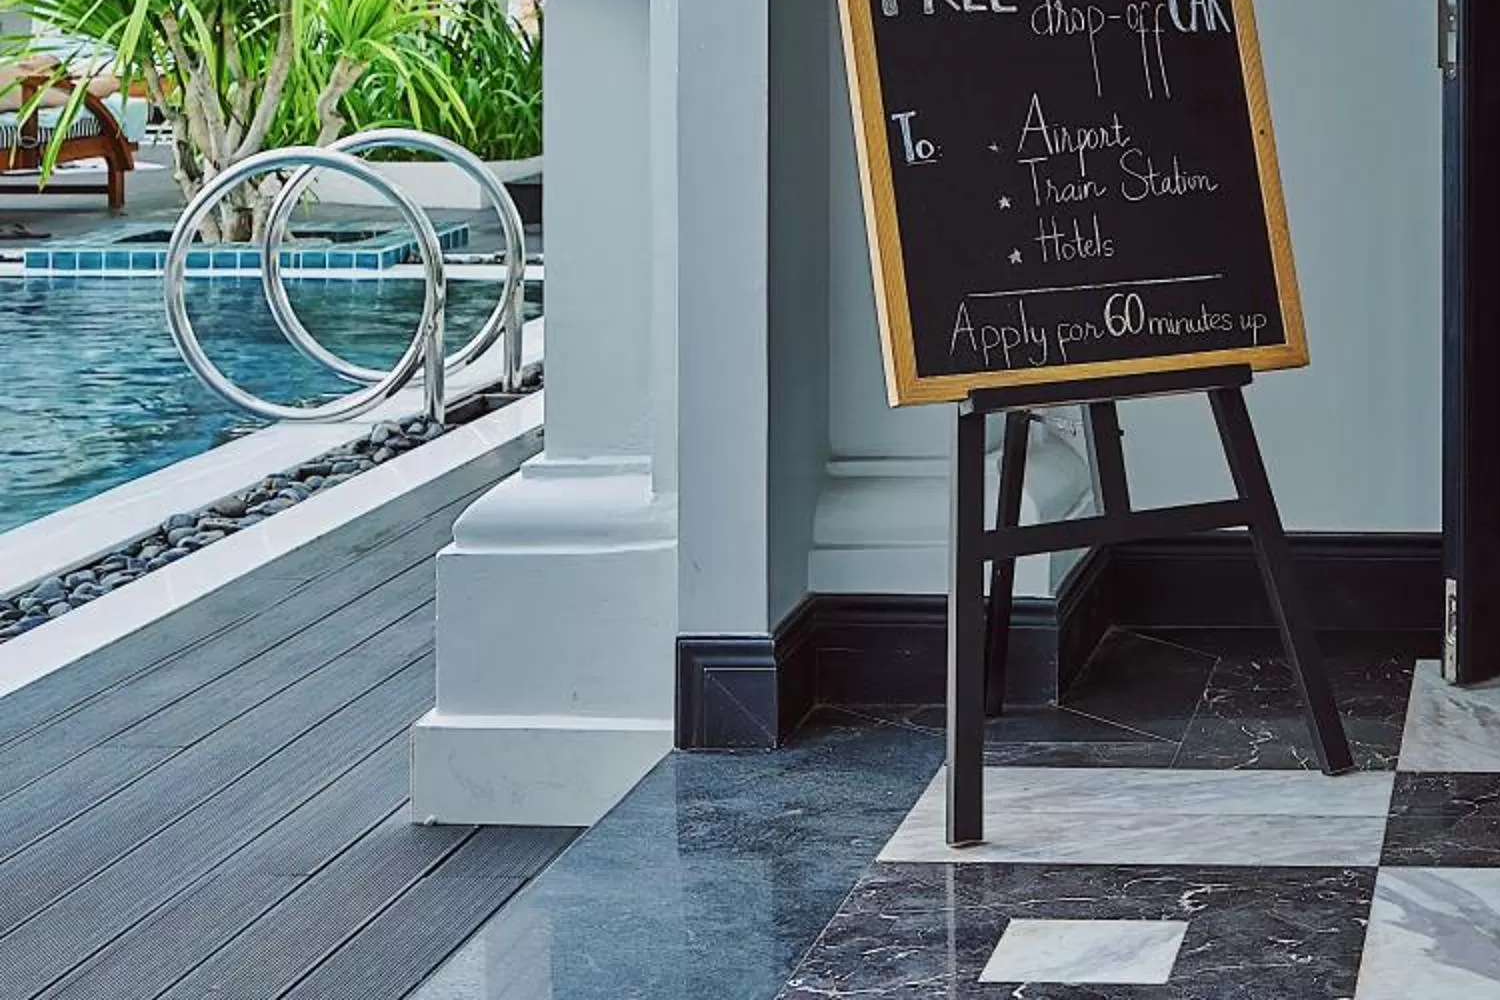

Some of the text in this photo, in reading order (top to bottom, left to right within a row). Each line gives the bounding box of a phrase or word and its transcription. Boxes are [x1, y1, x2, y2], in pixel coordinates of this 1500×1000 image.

[1018, 92, 1131, 176] Airport
[1017, 149, 1218, 206] Train Station
[1035, 212, 1115, 263] Hotels
[950, 293, 1267, 368] Apply for 60 minutes up
